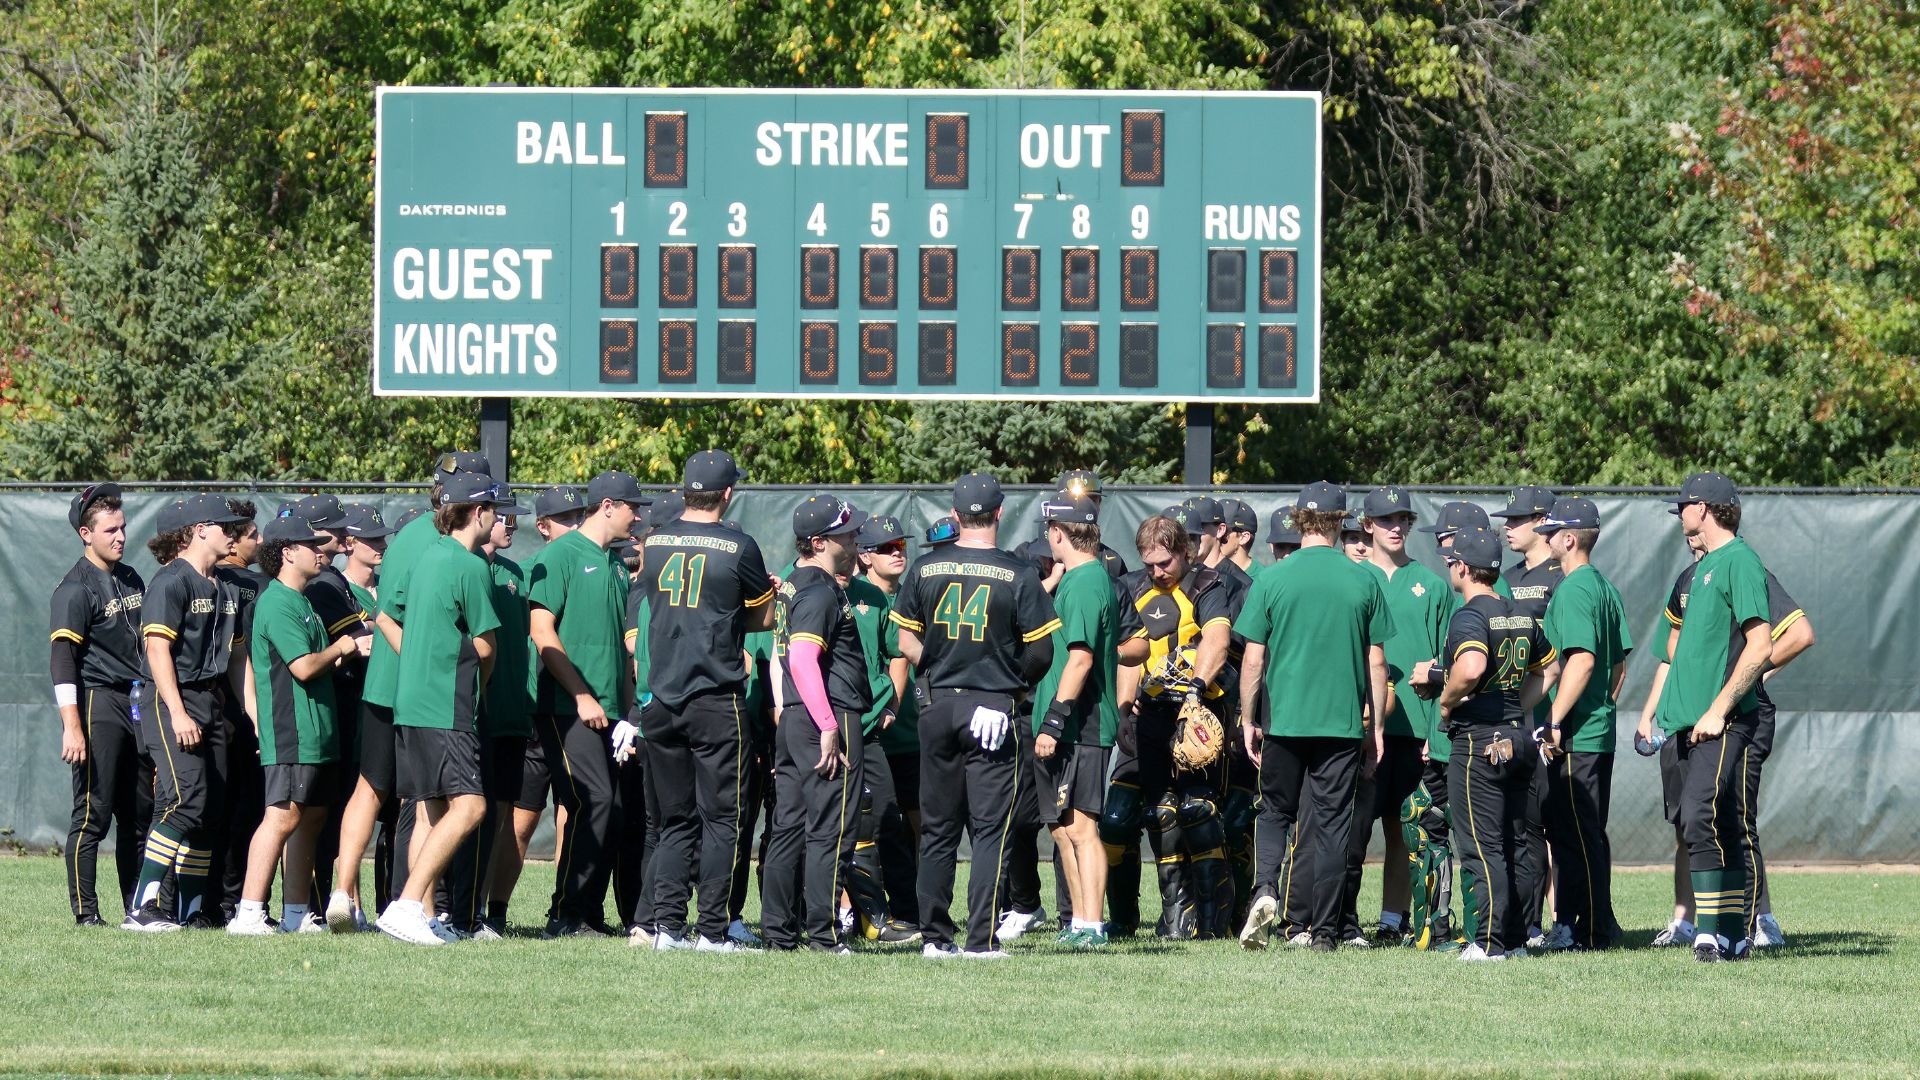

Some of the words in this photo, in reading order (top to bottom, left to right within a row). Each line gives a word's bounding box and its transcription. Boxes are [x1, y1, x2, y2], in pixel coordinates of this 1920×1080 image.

[516, 121, 626, 165] BALL
[647, 113, 685, 183] 0
[756, 121, 909, 166] STRIKE
[928, 115, 966, 184] 0
[1020, 123, 1111, 169] OUT
[1124, 112, 1162, 182] 0
[399, 204, 507, 216] DAKTRONICS
[610, 202, 625, 236] 1
[668, 202, 688, 236] 2
[727, 203, 747, 237] 3
[806, 203, 827, 237] 4
[870, 203, 891, 237] 5
[929, 203, 949, 239] 6
[1013, 204, 1033, 239] 7
[1072, 204, 1091, 239] 8
[1130, 205, 1150, 240] 9
[1204, 204, 1301, 241] RUNS
[393, 247, 553, 301] GUEST
[604, 246, 634, 301] 0
[663, 246, 693, 301] 0
[722, 247, 753, 302] 0
[805, 248, 835, 303] 0
[863, 248, 894, 303] 0
[922, 249, 953, 303] 0
[1006, 249, 1036, 304] 0
[1065, 249, 1095, 304] 0
[1124, 250, 1155, 304] 0
[1263, 251, 1294, 306] 0
[394, 322, 558, 376] KNIGHTS
[604, 321, 634, 377] 2
[663, 321, 693, 377] 0
[805, 322, 835, 378] 0
[863, 323, 893, 378] 5
[1006, 324, 1036, 380] 6
[1065, 324, 1095, 380] 2
[680, 535, 738, 554] KNIGHTS
[921, 561, 958, 577] GREEN
[962, 563, 1014, 582] KNIGHTS
[658, 552, 706, 608] 41
[934, 582, 991, 642] 44
[1482, 636, 1531, 693] 29
